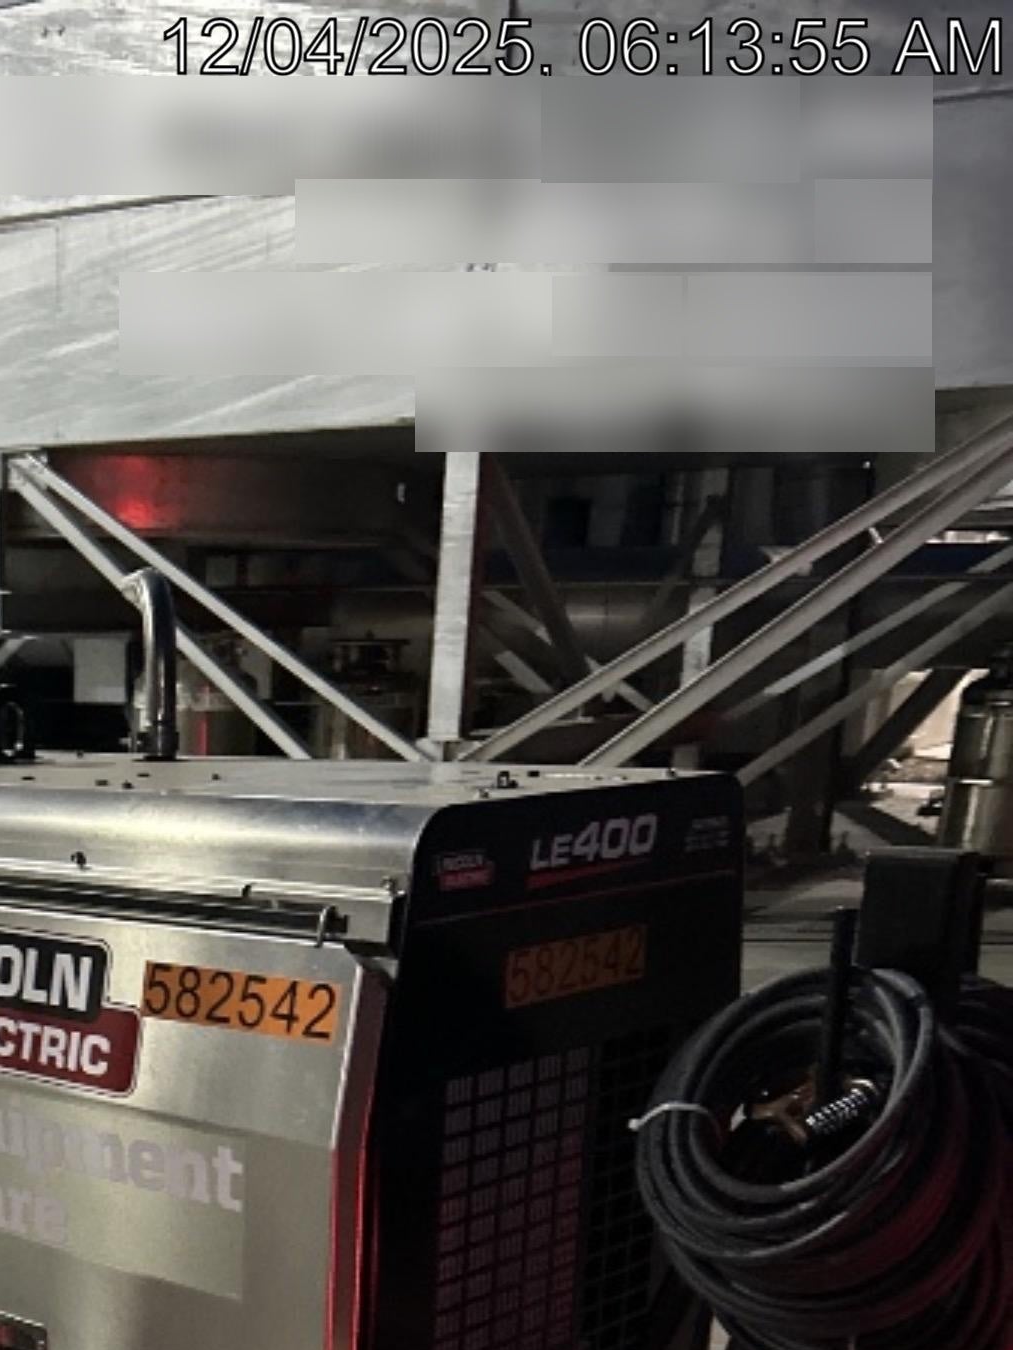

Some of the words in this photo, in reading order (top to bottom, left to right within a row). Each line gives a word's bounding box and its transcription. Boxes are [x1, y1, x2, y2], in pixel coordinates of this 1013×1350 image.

[529, 812, 658, 871] LE400
[145, 962, 337, 1040] 582542
[510, 926, 644, 1003] 582542
